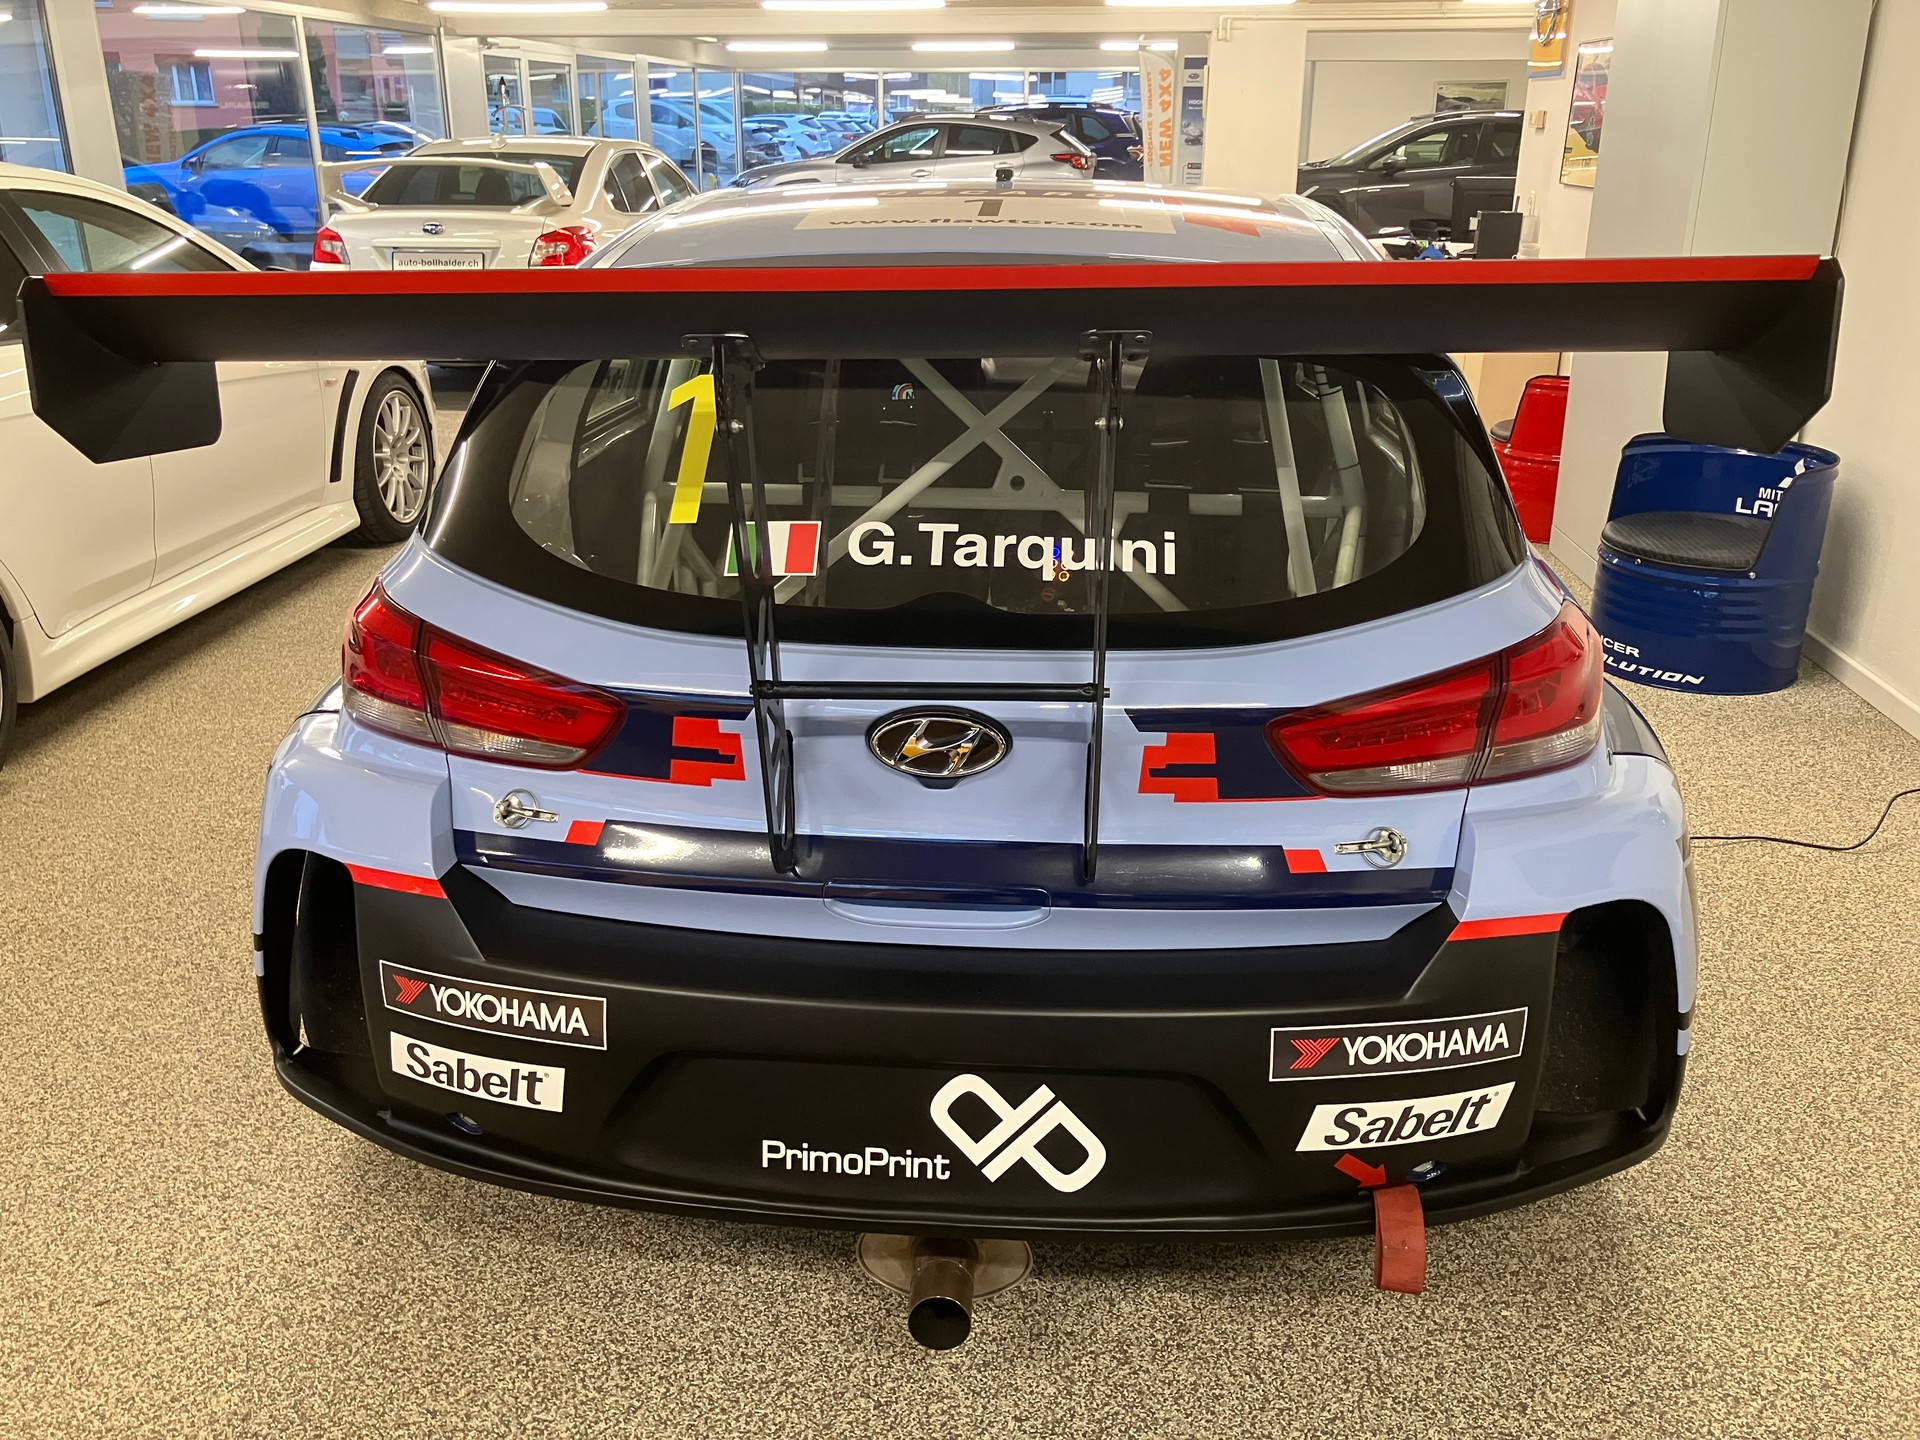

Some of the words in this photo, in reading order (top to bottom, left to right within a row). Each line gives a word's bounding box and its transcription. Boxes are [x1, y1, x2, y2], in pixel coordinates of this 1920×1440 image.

[828, 217, 1144, 230] www.flawtcr.com
[397, 258, 479, 268] auto-bollhalder.ch
[667, 374, 716, 524] 1
[1735, 496, 1779, 518] LA
[1600, 634, 1640, 658] CER
[429, 983, 590, 1038] YOKOHAMA
[1341, 1022, 1510, 1067] YOKOHAMA
[405, 1042, 546, 1106] Sabelt
[1324, 1092, 1493, 1147] Sabelt
[761, 1140, 951, 1181] PrimoPrint
